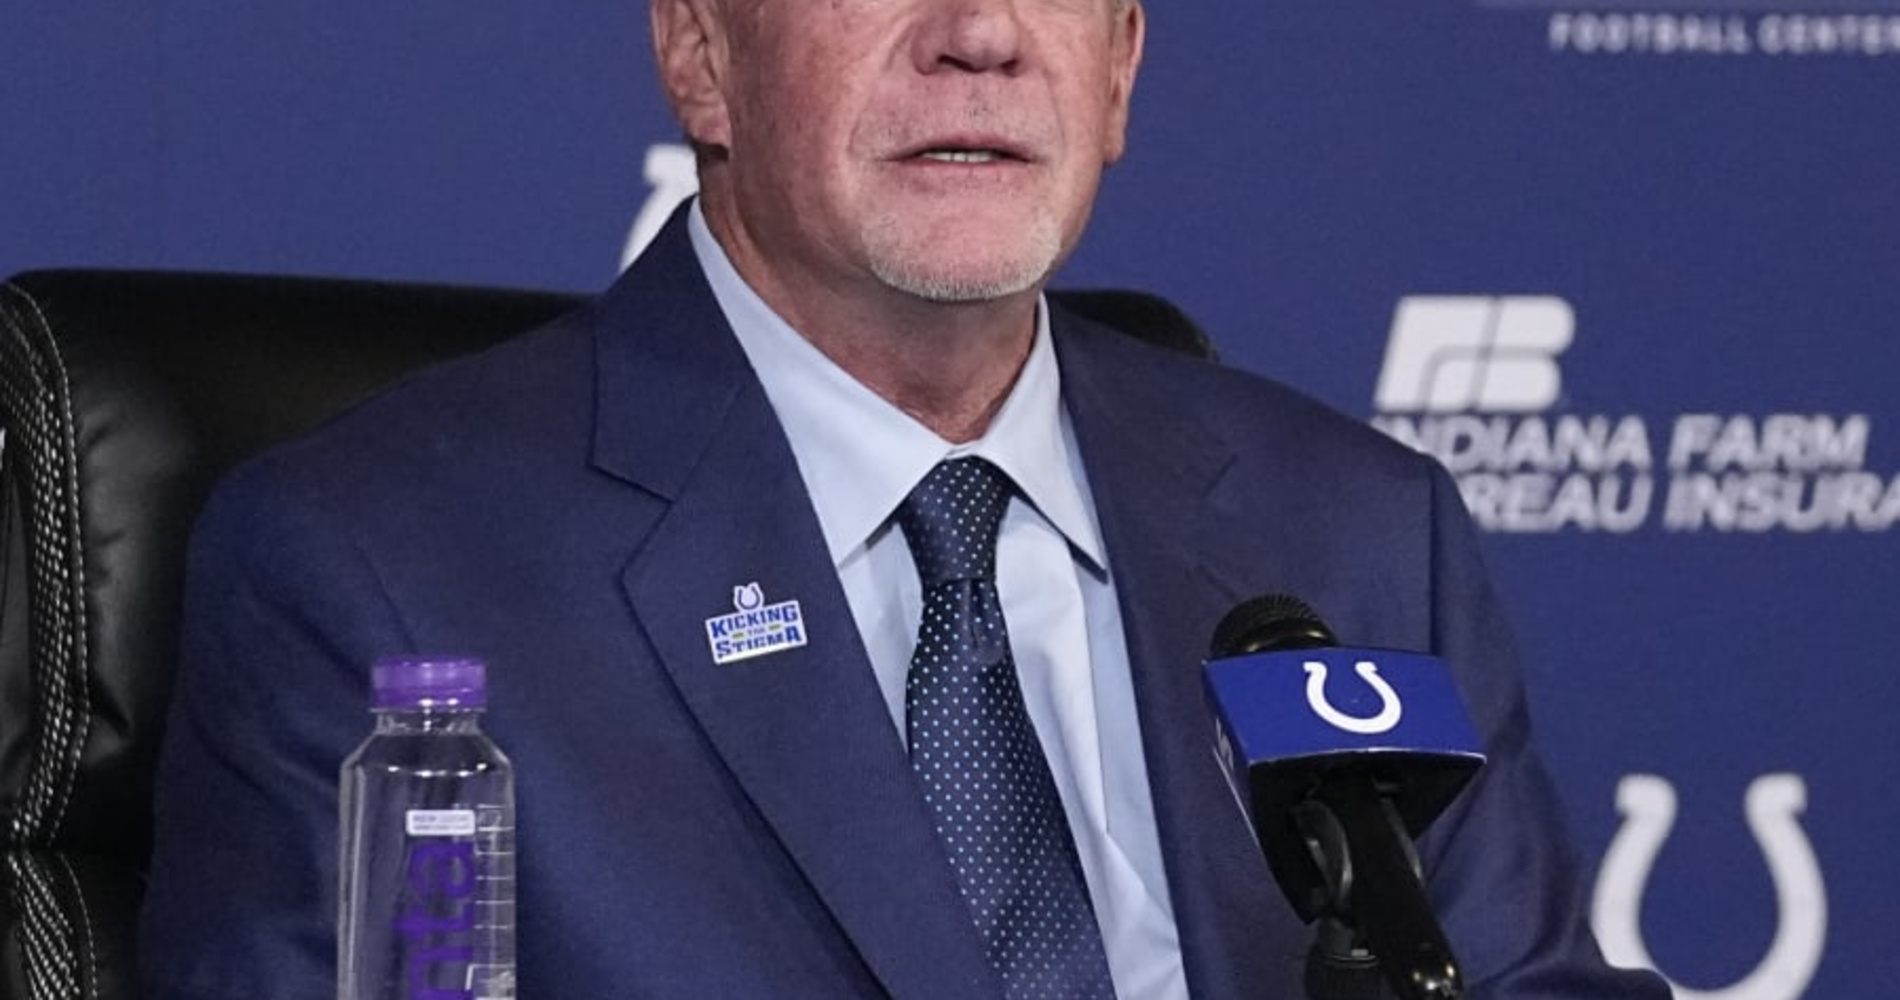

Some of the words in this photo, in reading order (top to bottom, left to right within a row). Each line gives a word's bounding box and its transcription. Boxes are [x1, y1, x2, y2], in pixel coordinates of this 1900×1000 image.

[1548, 11, 1751, 53] FOOTBALL
[1371, 414, 1652, 473] NDIANA
[1668, 412, 1871, 473] FARM
[1459, 471, 1654, 533] REAU
[710, 604, 798, 638] KICKING
[715, 625, 802, 659] STIGMA
